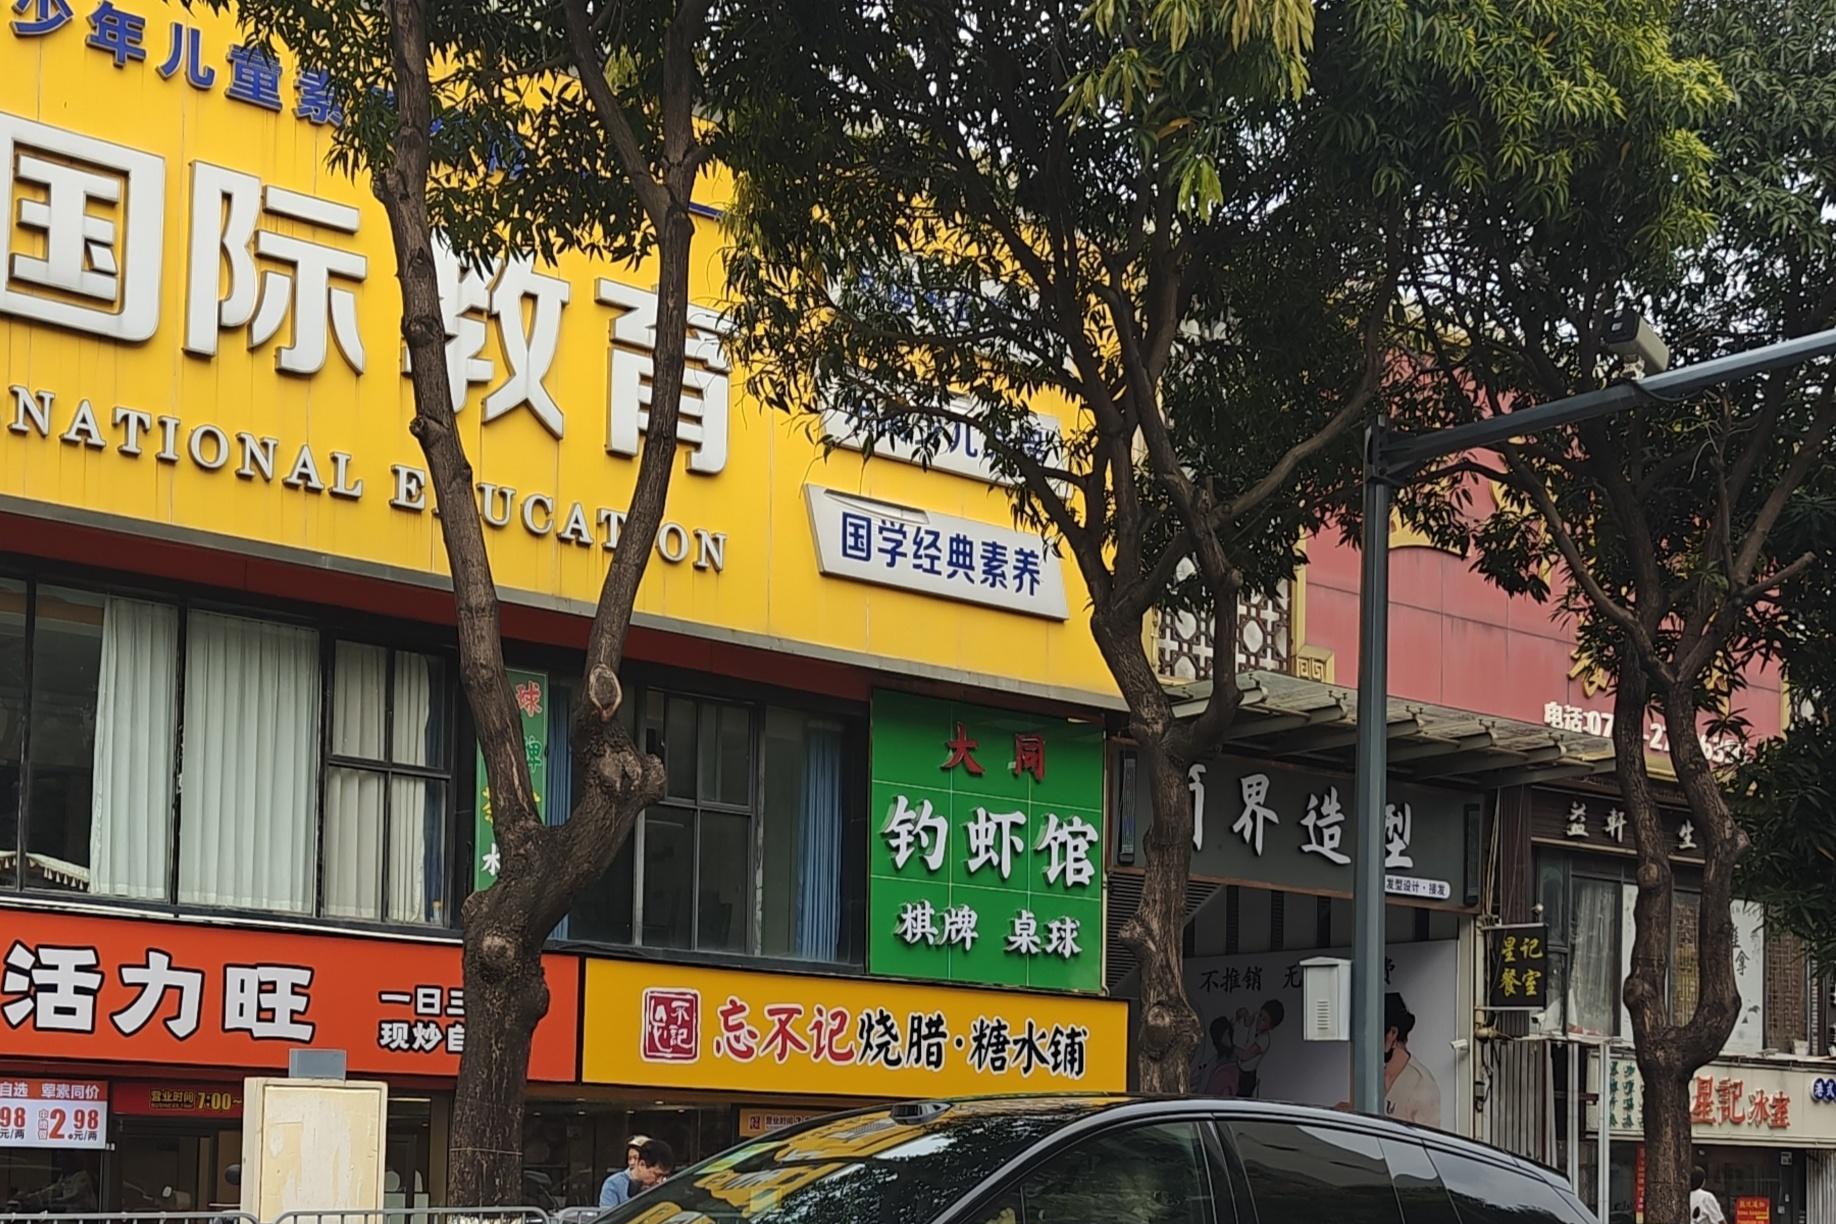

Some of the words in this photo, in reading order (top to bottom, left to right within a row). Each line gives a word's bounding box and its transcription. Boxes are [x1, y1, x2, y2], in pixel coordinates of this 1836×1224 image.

[0, 112, 736, 476] 国际教育
[8, 384, 364, 500] NATIONAL
[390, 463, 728, 574] EUCATON
[841, 511, 1041, 596] 国学经典素养
[941, 722, 1048, 781] 大同
[881, 795, 1099, 888] 钓虾馆
[896, 899, 980, 952] 棋牌
[1005, 909, 1084, 960] 桌球
[1500, 936, 1545, 964] 星记
[2, 940, 315, 1041] 活力旺
[1199, 965, 1263, 994] 不推销
[1500, 967, 1542, 998] 餐室
